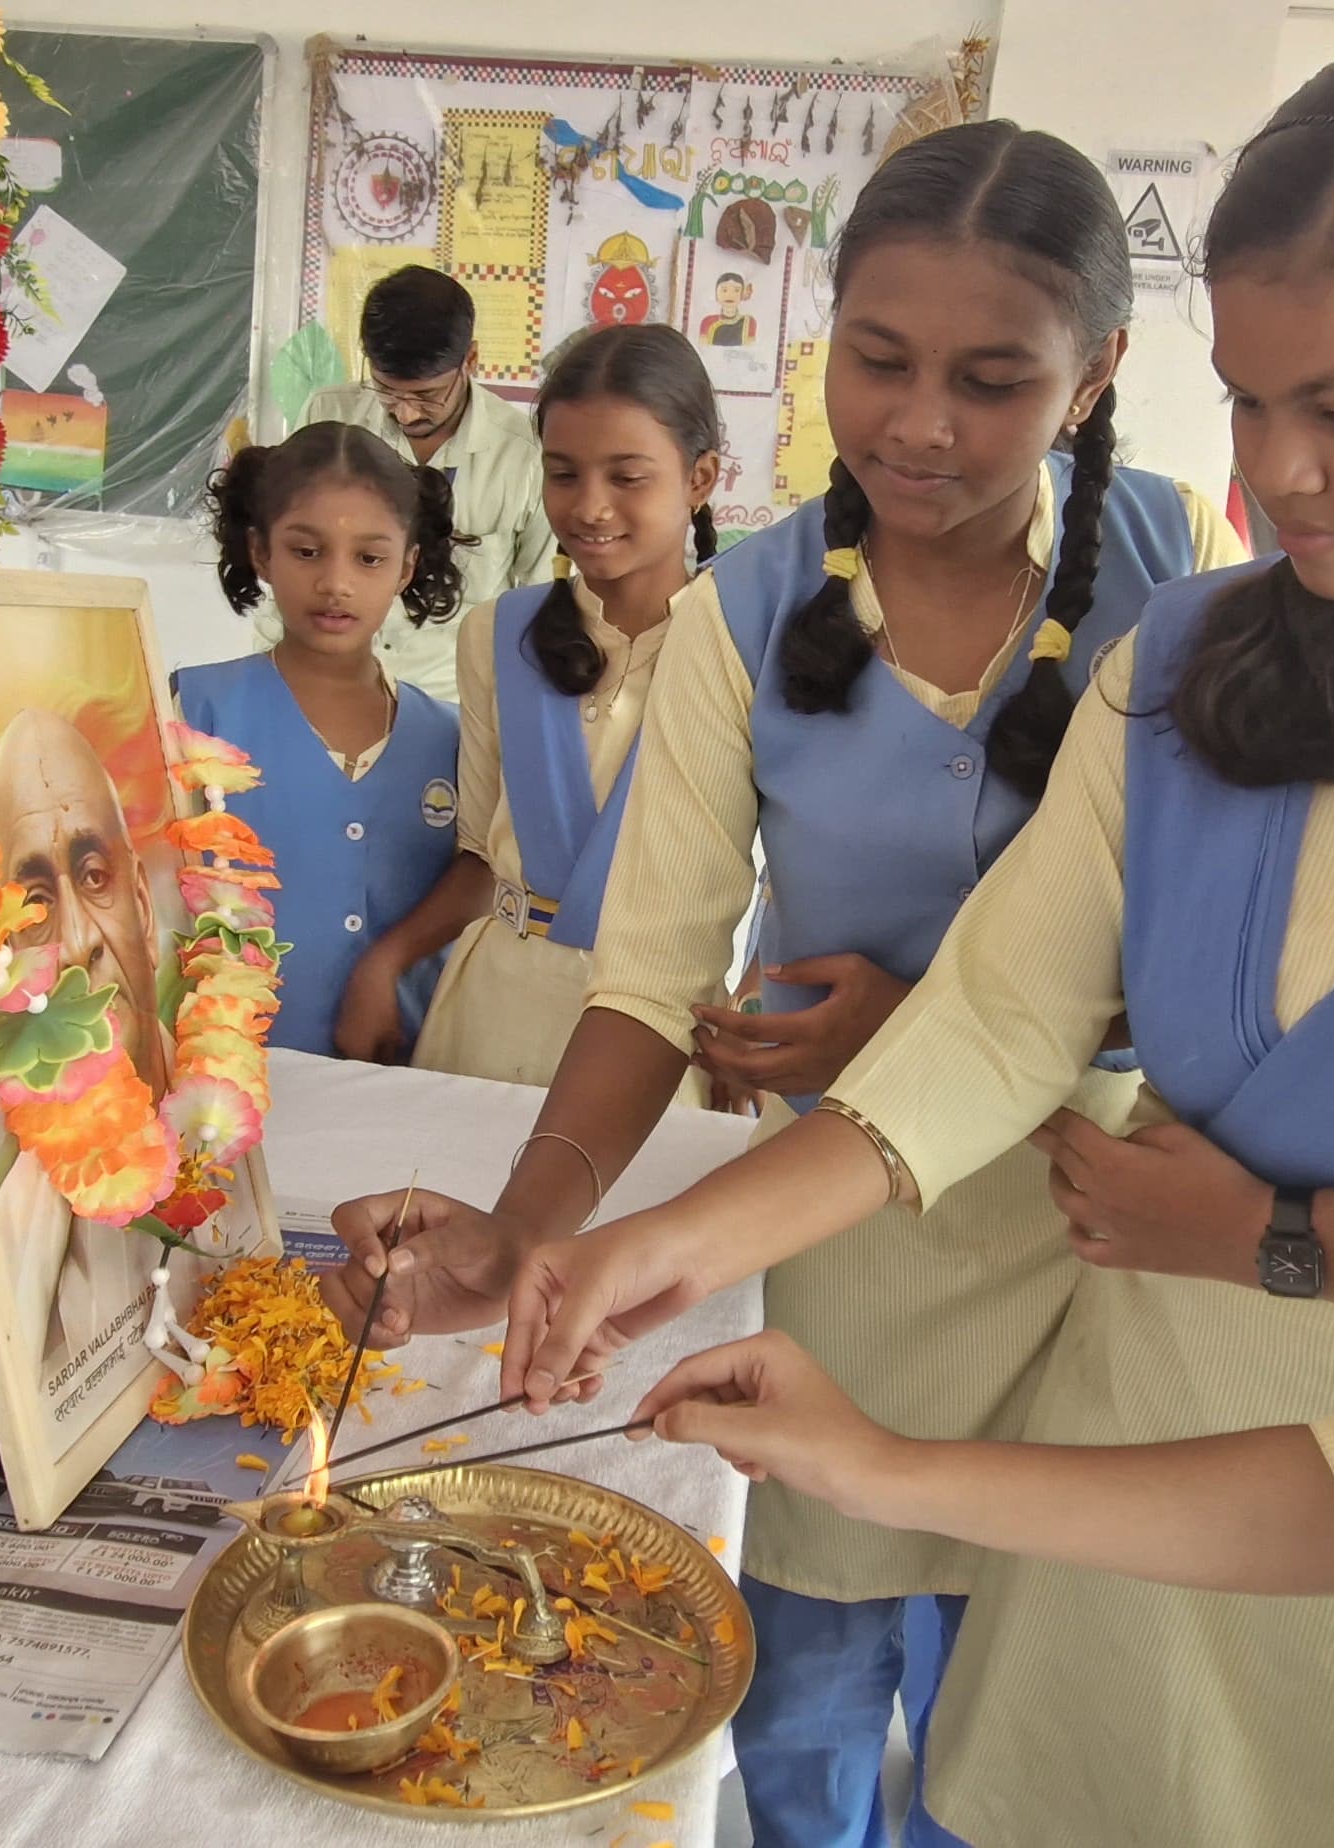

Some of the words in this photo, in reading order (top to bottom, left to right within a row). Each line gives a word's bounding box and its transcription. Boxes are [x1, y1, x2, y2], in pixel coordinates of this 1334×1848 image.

[1118, 157, 1193, 174] WARNING
[48, 1349, 89, 1397] SARDAR
[87, 1292, 148, 1356] VALLABHBHAI
[106, 1530, 160, 1544] BOLERO
